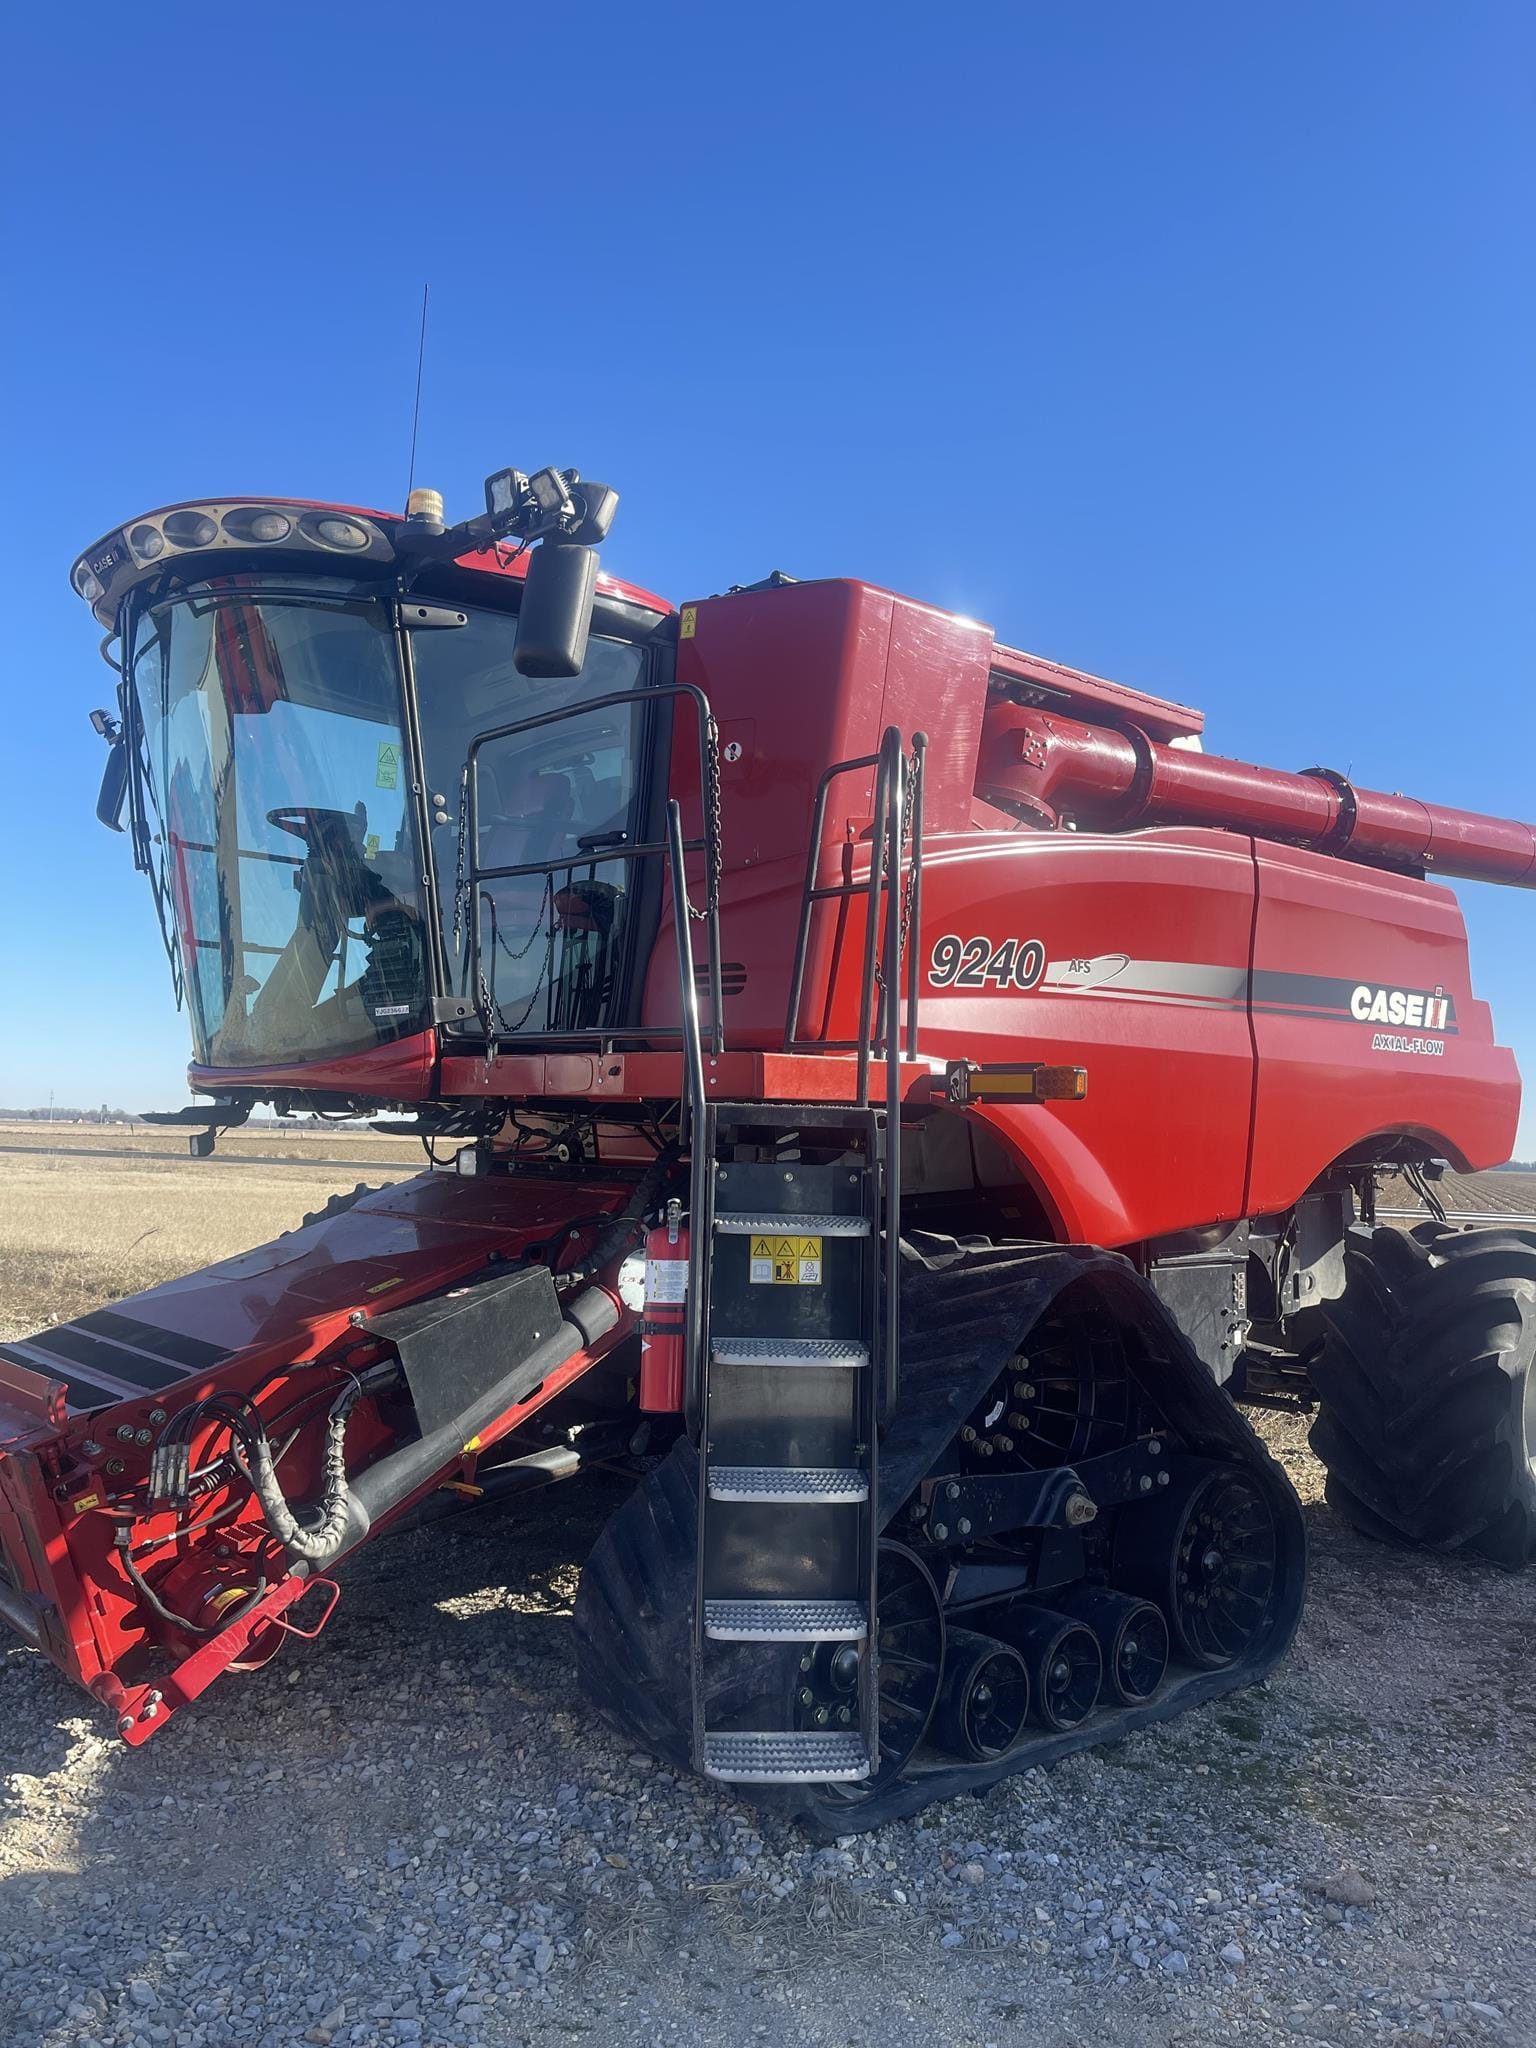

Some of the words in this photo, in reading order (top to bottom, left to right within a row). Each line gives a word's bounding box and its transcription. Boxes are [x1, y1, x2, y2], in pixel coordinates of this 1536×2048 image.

[94, 555, 113, 574] CASE
[928, 934, 1045, 990] 9240
[1068, 958, 1091, 974] AFS
[1350, 985, 1424, 1027] CASE
[1371, 1033, 1445, 1056] AXIAL-FLOW
